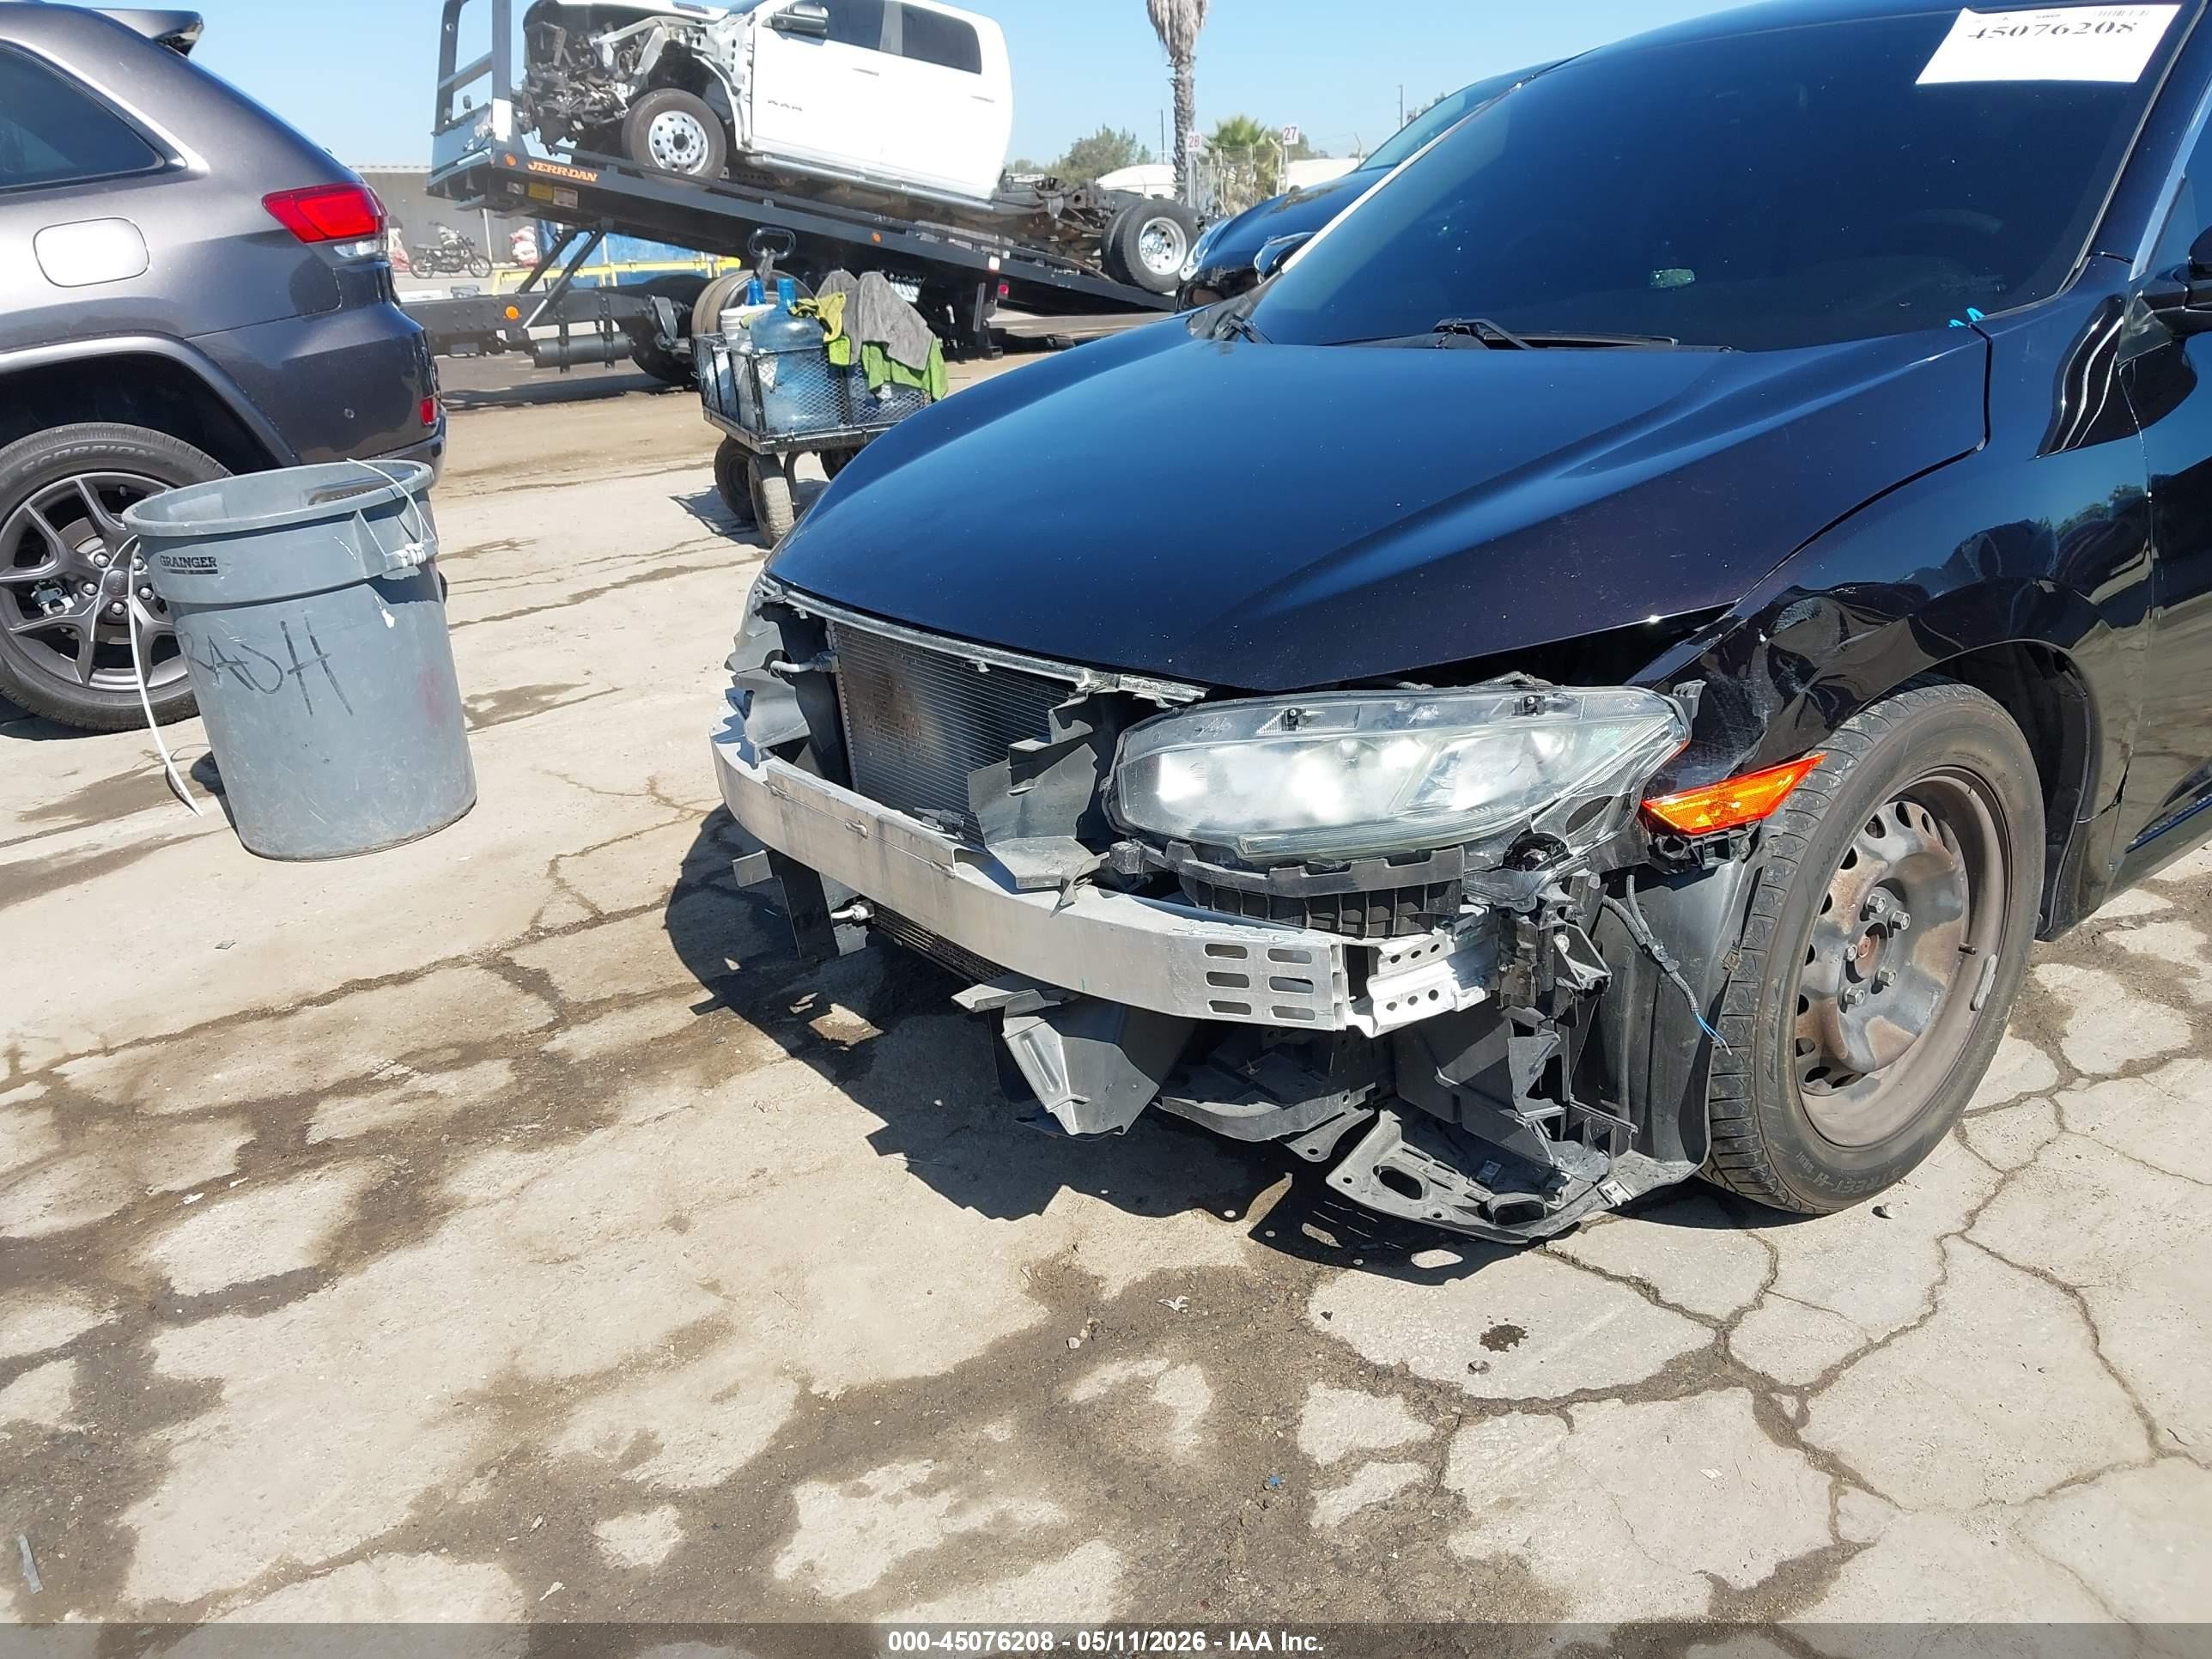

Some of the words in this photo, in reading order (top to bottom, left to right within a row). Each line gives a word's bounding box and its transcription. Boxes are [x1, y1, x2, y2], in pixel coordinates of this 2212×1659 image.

[1967, 20, 2138, 40] 45076208
[1284, 126, 1297, 141] 27
[1188, 136, 1200, 148] 28
[160, 555, 218, 568] GRAINGER
